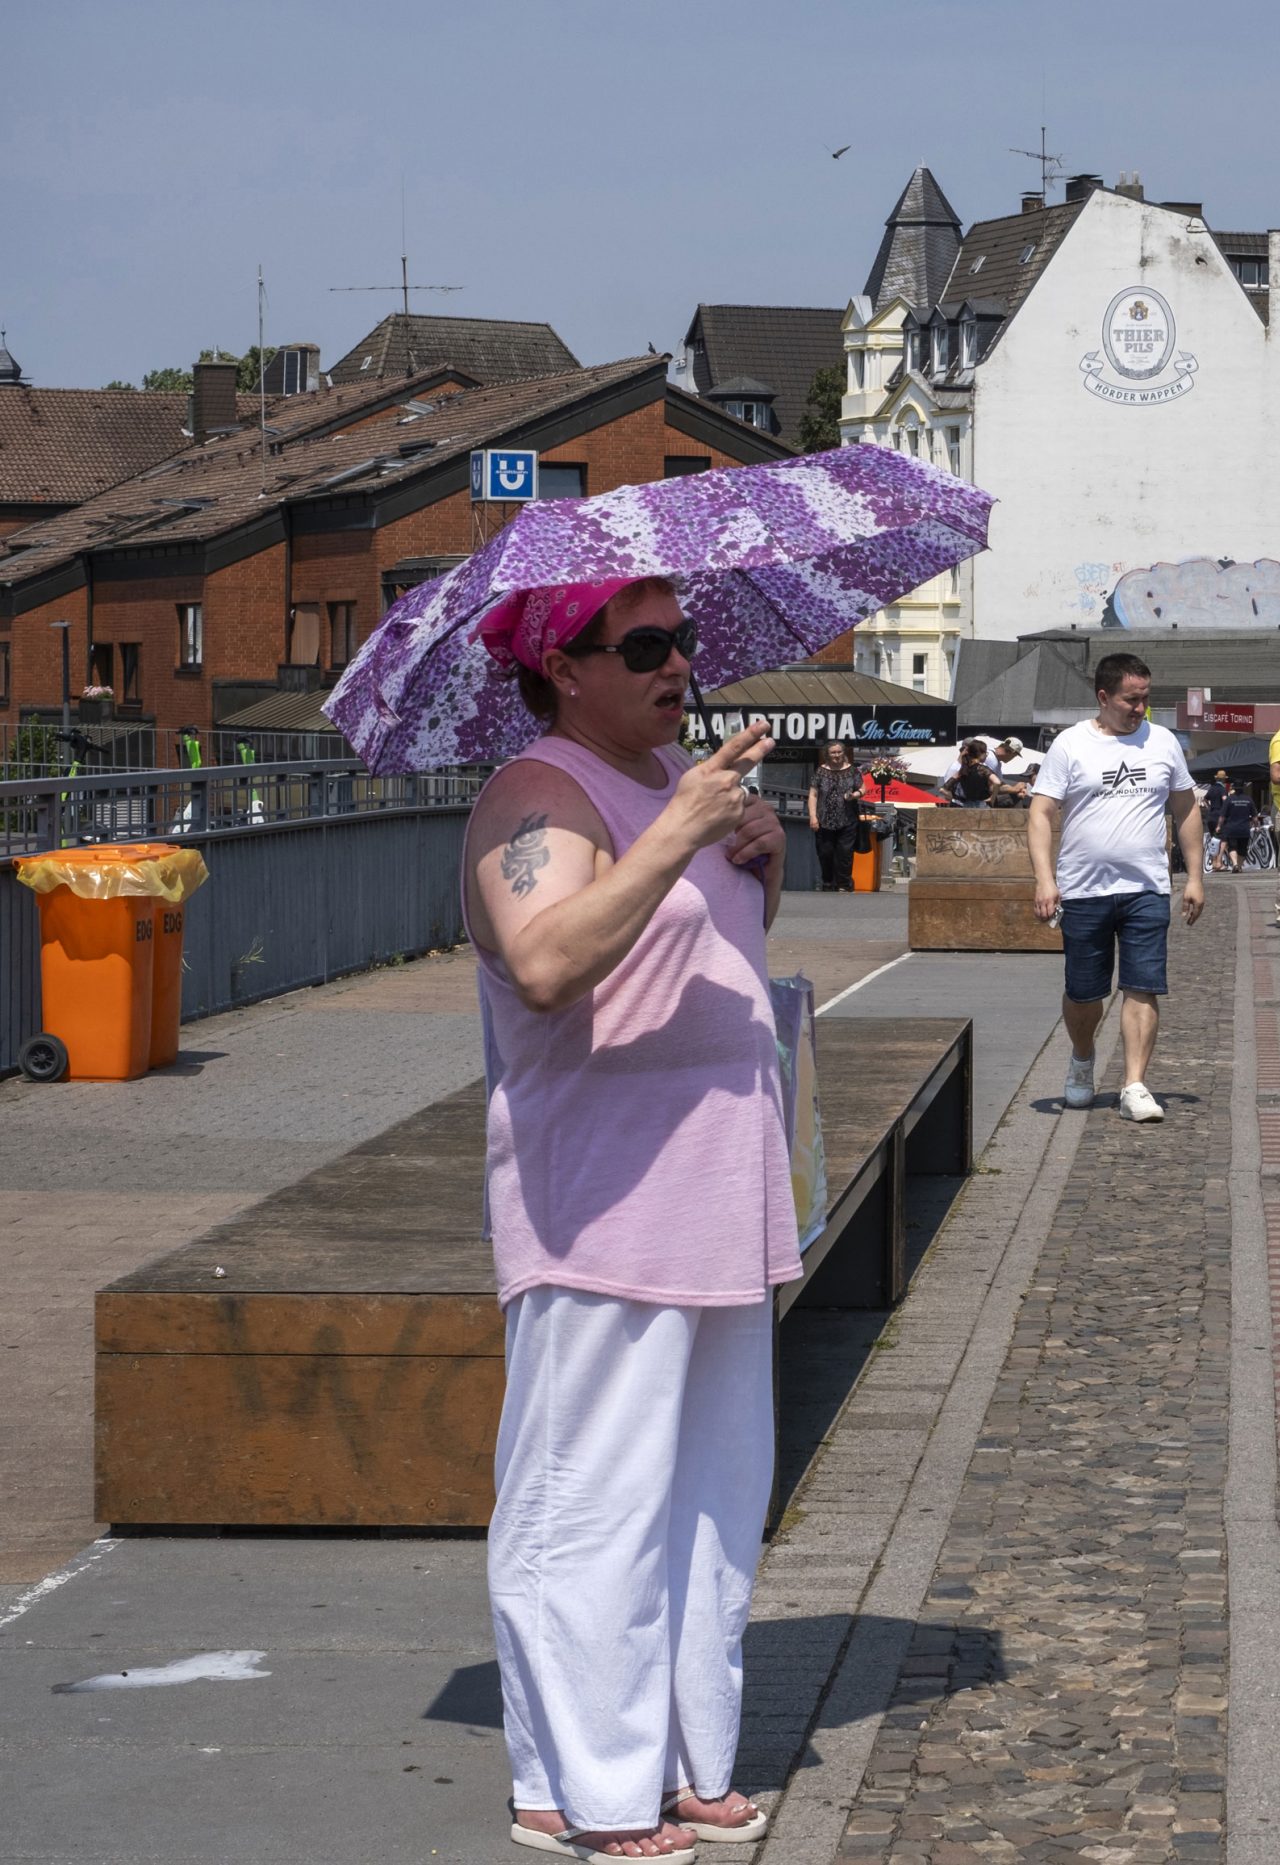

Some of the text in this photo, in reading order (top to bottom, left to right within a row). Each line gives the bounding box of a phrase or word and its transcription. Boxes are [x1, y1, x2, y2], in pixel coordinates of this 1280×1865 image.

[1113, 329, 1165, 342] THIER
[1124, 343, 1154, 353] PILS
[1140, 383, 1183, 401] WAPPEN
[1203, 711, 1253, 724] EISCAFÉ TORINO
[687, 713, 933, 740] HARTOPIA Ihr Friseur
[1115, 787, 1158, 796] INDUSTRIES
[136, 919, 153, 942] EDG
[164, 912, 183, 934] EDG
